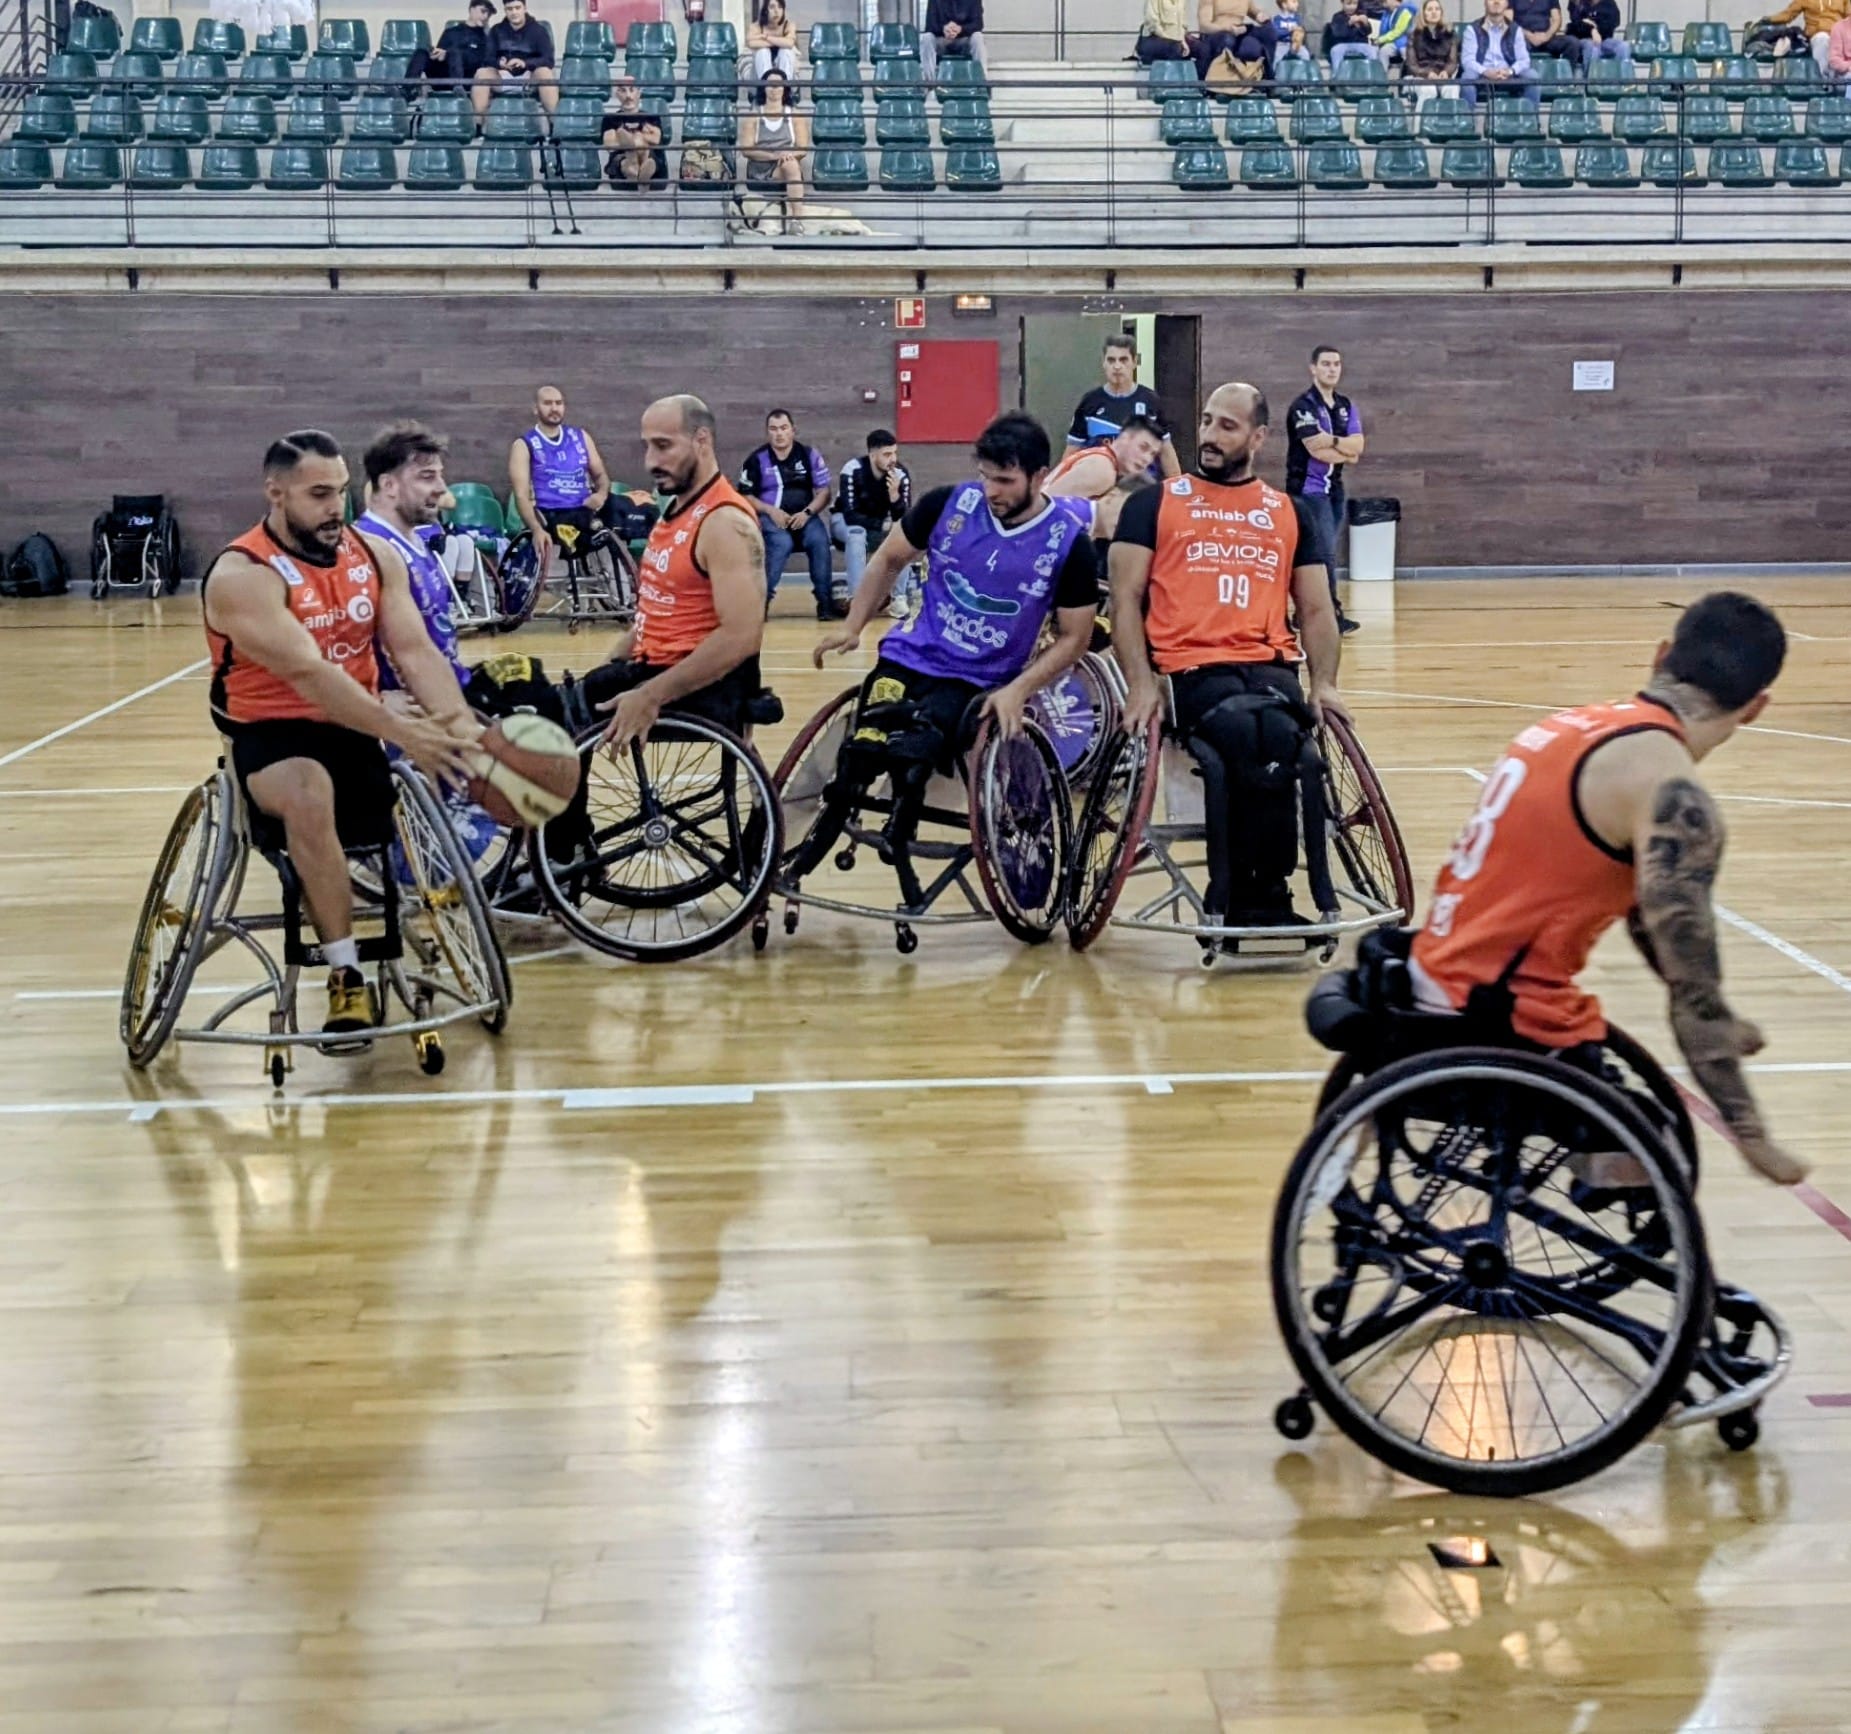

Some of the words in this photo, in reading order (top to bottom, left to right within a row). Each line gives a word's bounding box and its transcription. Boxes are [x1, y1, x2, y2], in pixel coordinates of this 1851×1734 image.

[986, 549, 998, 572] 4
[1186, 540, 1279, 567] gaviota
[1218, 573, 1249, 609] 09
